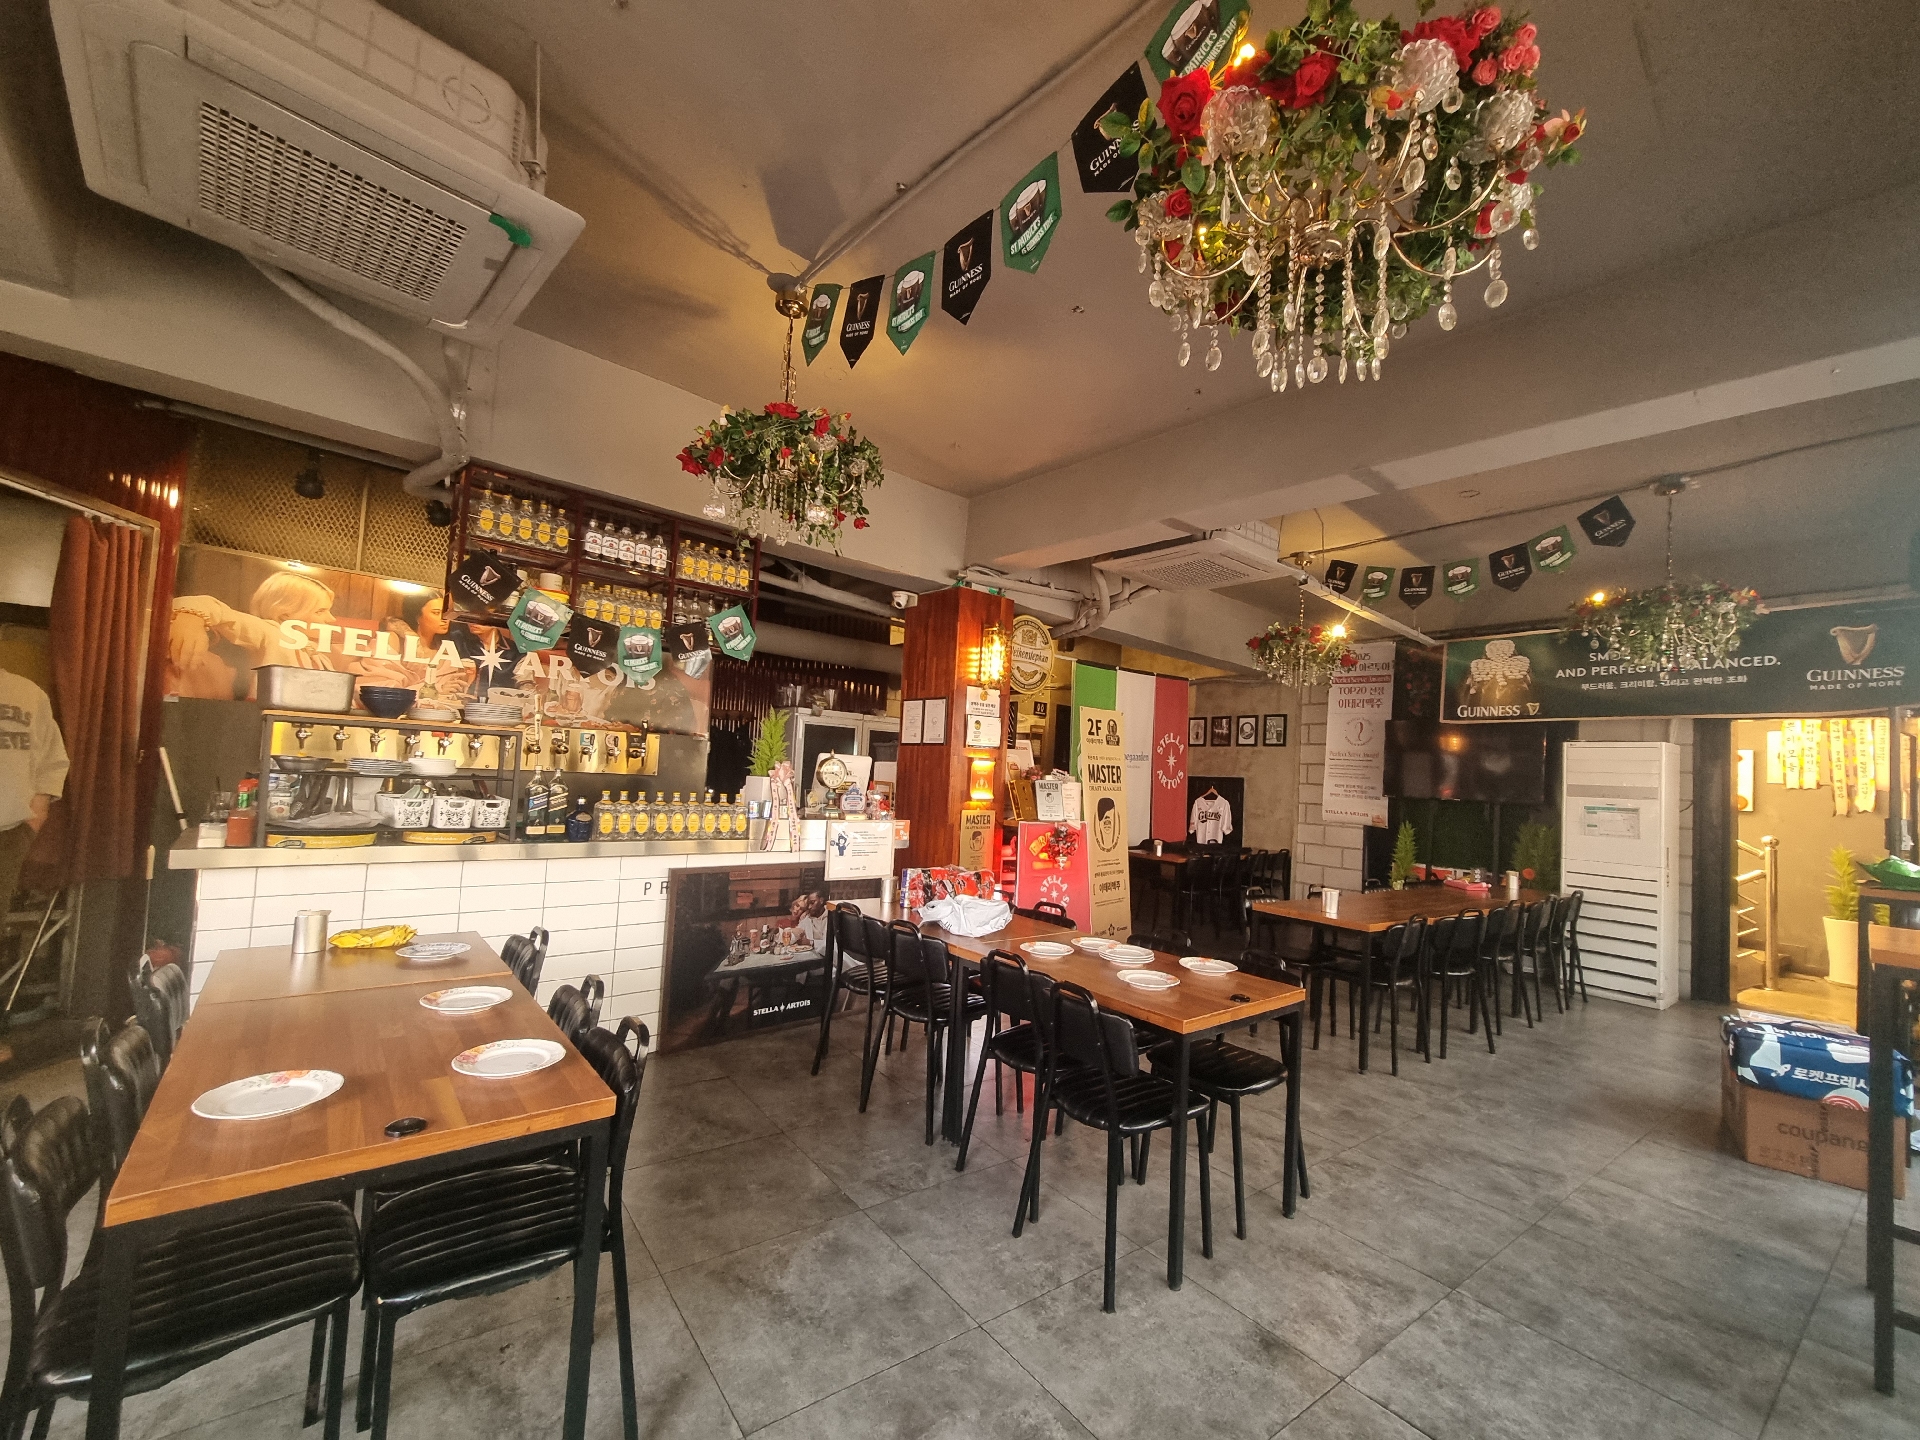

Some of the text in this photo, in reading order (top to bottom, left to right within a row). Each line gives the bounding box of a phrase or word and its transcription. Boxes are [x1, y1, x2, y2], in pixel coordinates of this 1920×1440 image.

[948, 263, 983, 292] GUINNESS
[847, 320, 871, 332] GUINNESS
[461, 573, 495, 602] GUINNESS
[278, 619, 464, 669] STELLA
[573, 643, 608, 658] GUINNESS
[1556, 667, 1587, 679] AND
[1806, 666, 1905, 682] GUINNESS
[1339, 686, 1367, 696] TOP20
[1809, 683, 1842, 691] MADE
[1868, 680, 1902, 688] MORE
[1457, 704, 1521, 718] GUINNESS
[1087, 718, 1102, 736] 2F
[1157, 733, 1184, 755] STELLA
[1088, 764, 1122, 784] MASTER
[1157, 770, 1184, 789] ARTOIS
[1039, 782, 1059, 790] MASTER
[966, 815, 991, 825] MASTER
[1040, 875, 1068, 892] STELLA
[753, 999, 811, 1016] STELLA ARTOIS
